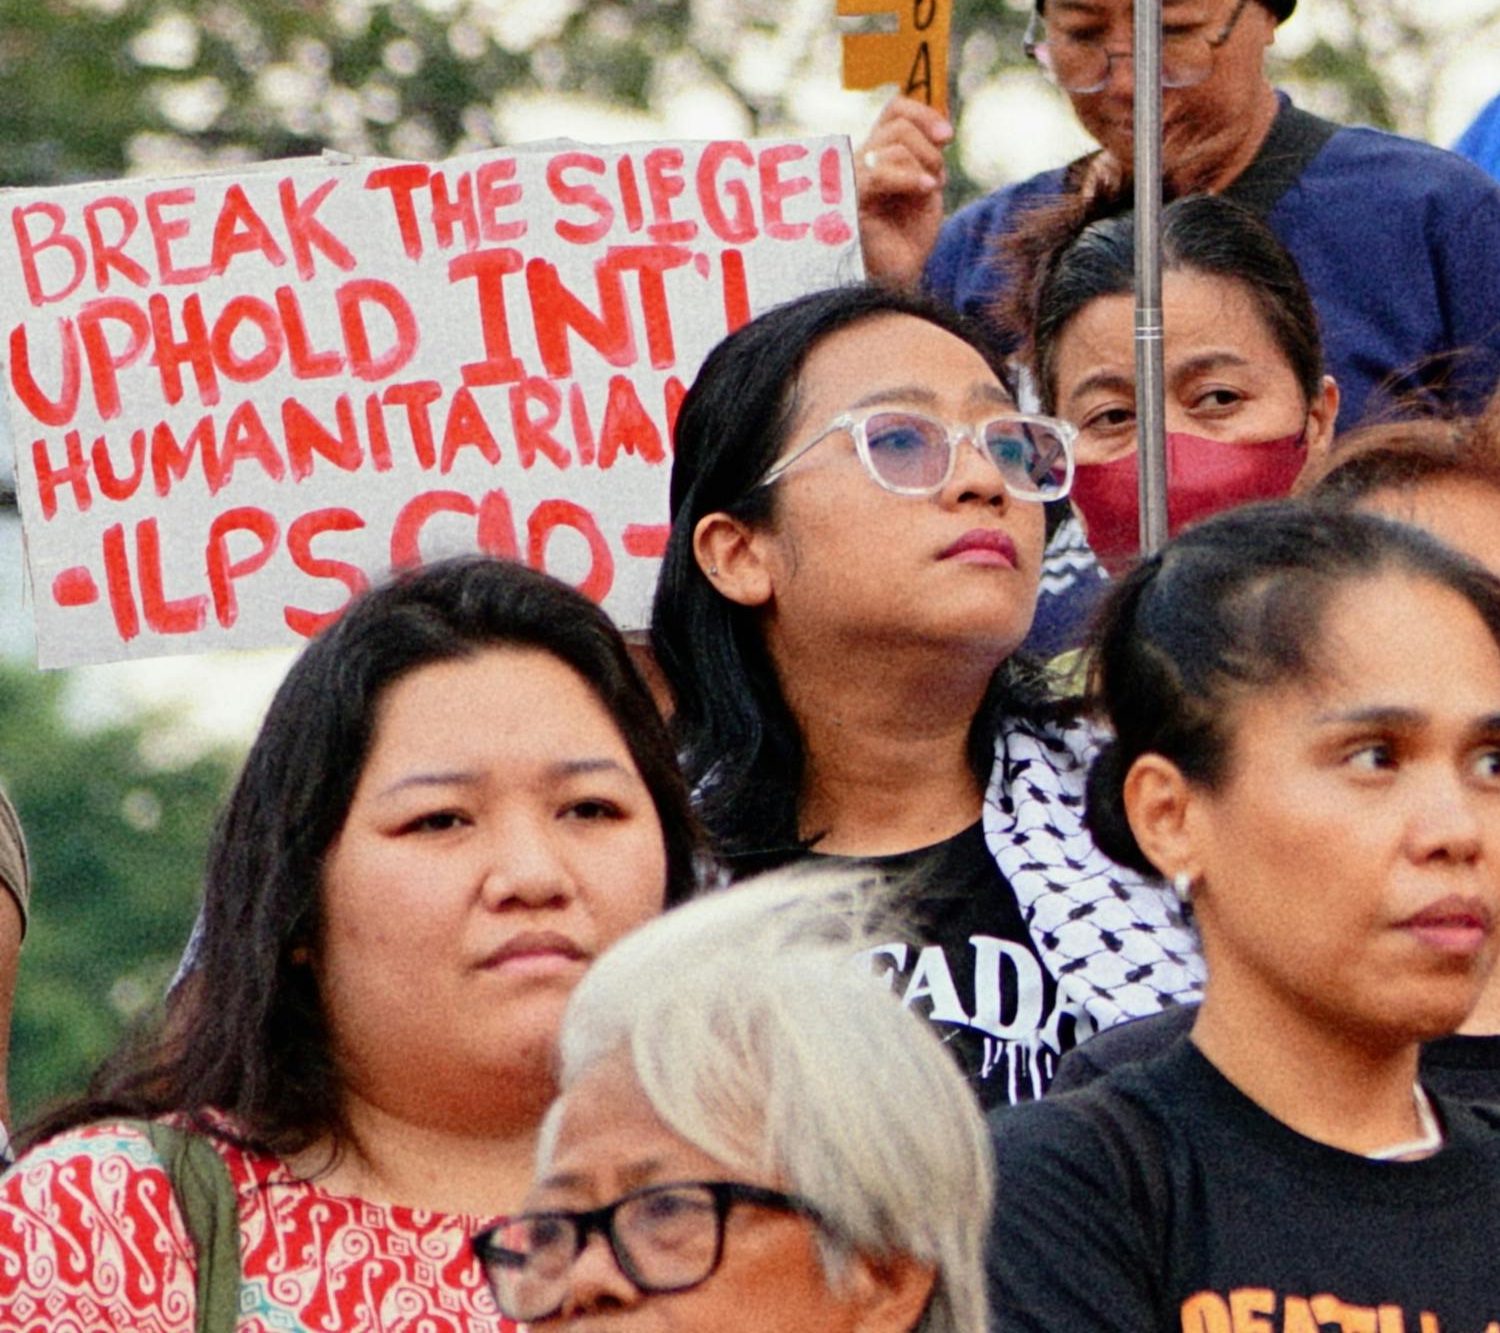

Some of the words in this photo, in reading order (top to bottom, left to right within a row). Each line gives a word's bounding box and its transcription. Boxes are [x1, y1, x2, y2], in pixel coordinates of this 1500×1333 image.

[11, 175, 359, 309] BREAK
[364, 156, 529, 262] THE
[544, 139, 853, 247] SIEGE!
[8, 278, 421, 427] UPHOLD
[31, 374, 690, 522] HUMANITARIA
